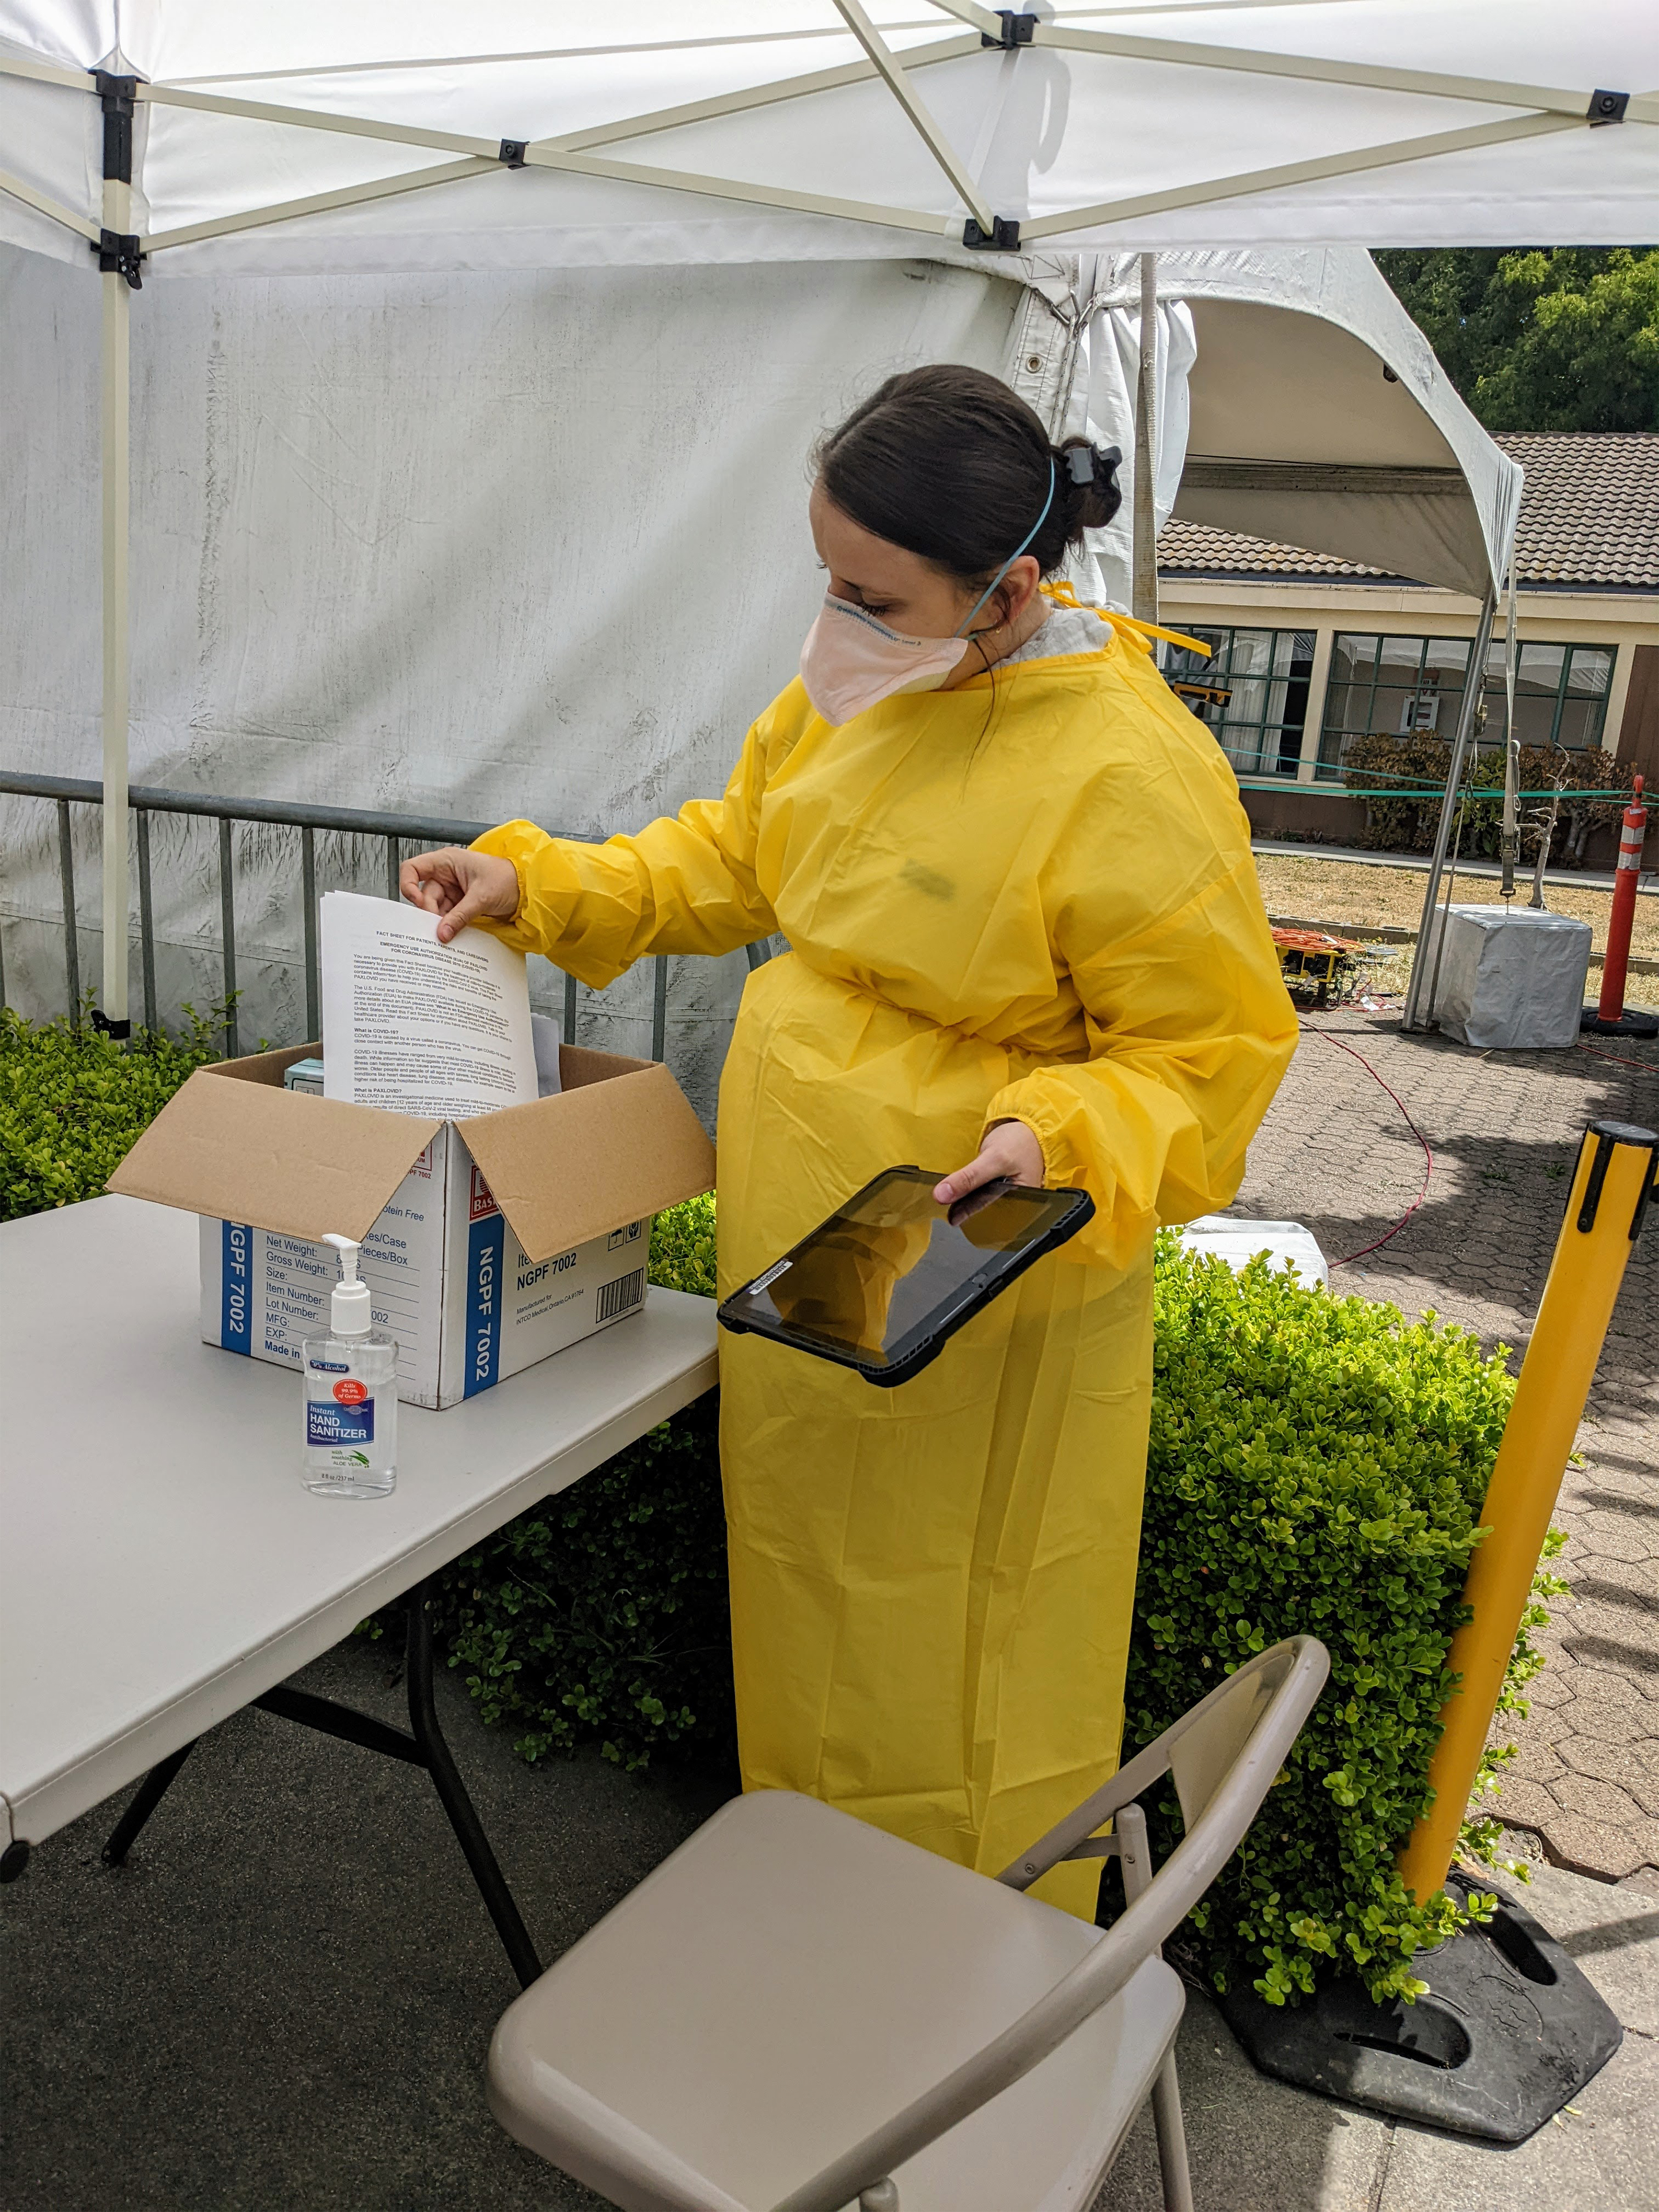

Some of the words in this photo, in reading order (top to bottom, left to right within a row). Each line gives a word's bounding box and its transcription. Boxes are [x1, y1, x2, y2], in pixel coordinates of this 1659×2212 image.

[380, 942, 409, 950] EMERGENCY
[402, 950, 434, 959] CORONAVIRUS
[474, 1196, 497, 1212] BASI
[383, 1205, 403, 1217] otein
[406, 1209, 424, 1221] Free
[267, 1235, 282, 1248] Net
[285, 1240, 317, 1257] Weight:
[366, 1232, 407, 1249] es/Case
[267, 1252, 292, 1266] Gross
[295, 1258, 328, 1275] Weight:
[518, 1253, 532, 1268] Ite
[266, 1267, 287, 1280] Size:
[517, 1264, 549, 1290] NGPF
[552, 1252, 576, 1274] 7002
[479, 1247, 493, 1316] NGPF
[266, 1282, 285, 1295] Item
[287, 1287, 324, 1306] Number:
[230, 1283, 244, 1334] 7002
[266, 1297, 279, 1309] Lot
[282, 1302, 319, 1320] Number:
[372, 1310, 388, 1323] 002
[517, 1297, 545, 1314] Manufactured
[266, 1312, 289, 1327] MFG:
[517, 1314, 531, 1325] INTCO
[266, 1326, 287, 1341] EXP:
[265, 1340, 289, 1355] Made
[292, 1349, 300, 1359] in
[476, 1323, 491, 1381] 7002
[310, 1405, 335, 1415] Instant
[310, 1413, 340, 1426] HAND
[310, 1424, 366, 1438] SANITIZER
[310, 1434, 338, 1442] Antibacterial
